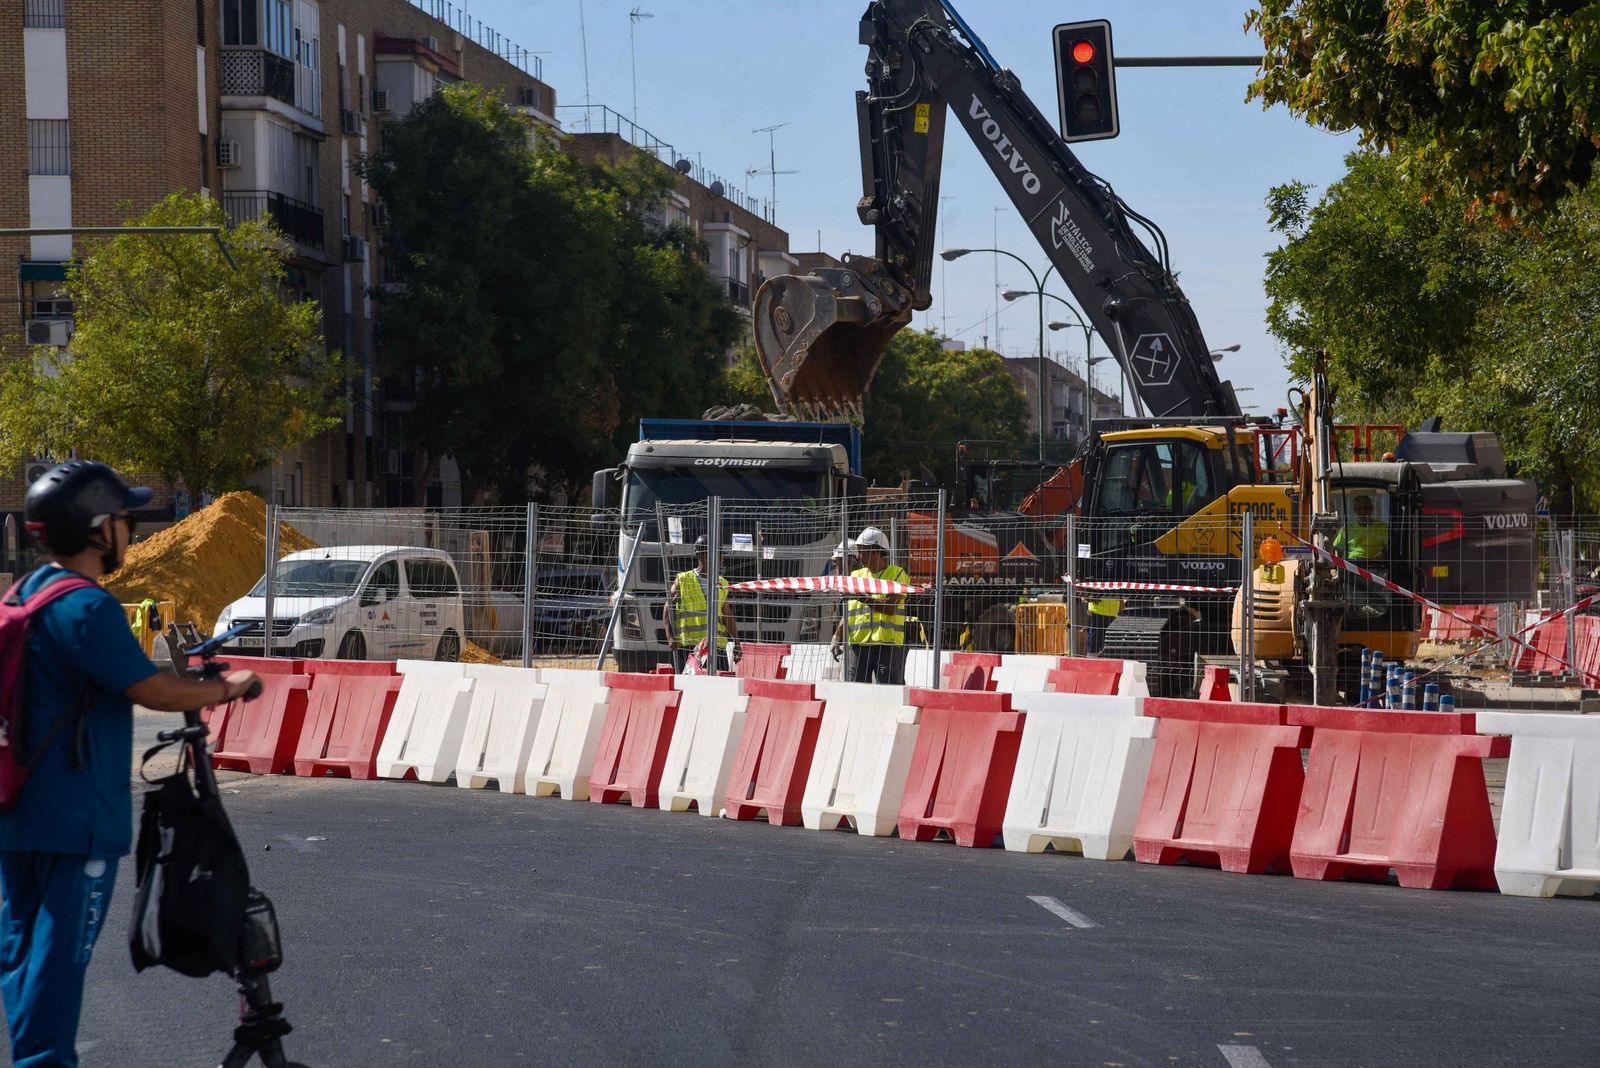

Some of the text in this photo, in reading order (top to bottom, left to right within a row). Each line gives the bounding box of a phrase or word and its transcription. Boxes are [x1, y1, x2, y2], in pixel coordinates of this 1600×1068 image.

[968, 93, 1041, 195] VOLVO
[1061, 224, 1095, 270] DEMOLICIONES
[1066, 218, 1092, 255] ITÁLICA
[694, 457, 770, 468] cotymsur
[1483, 512, 1528, 529] VOLVO
[1180, 561, 1225, 570] VOLVO
